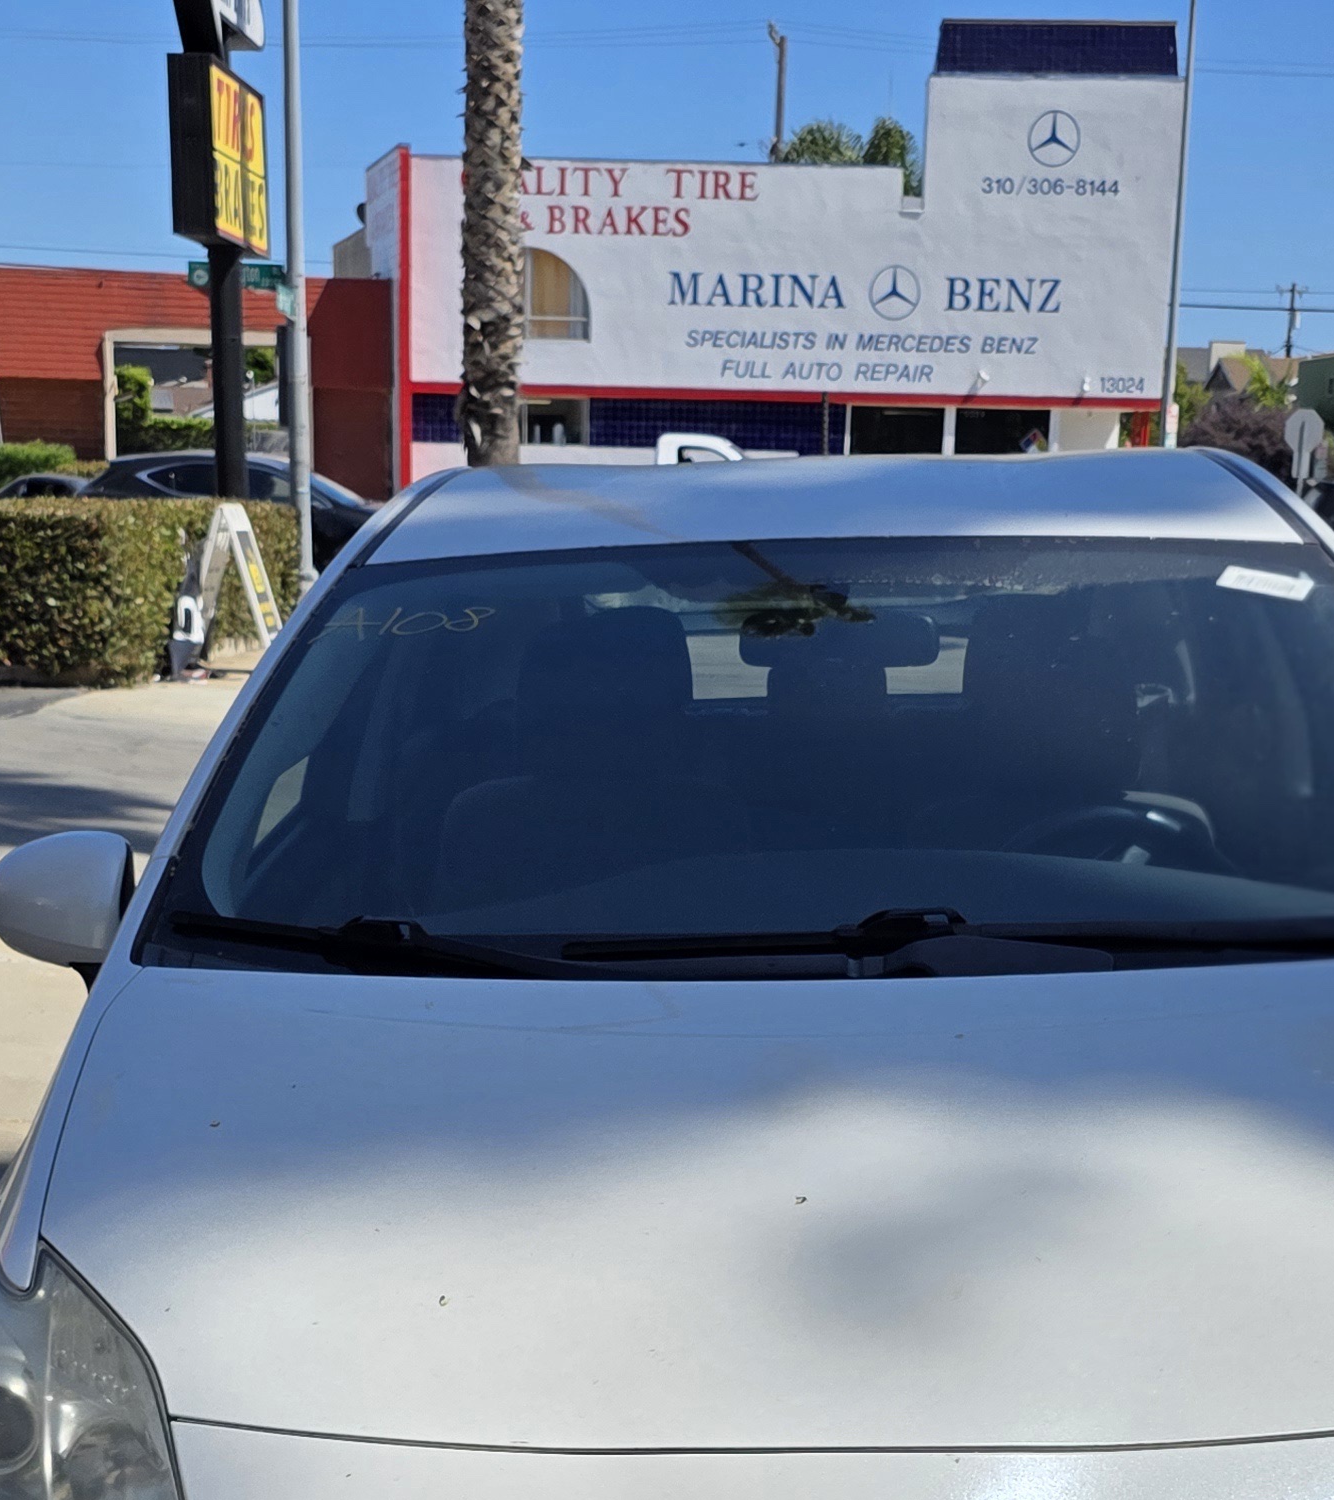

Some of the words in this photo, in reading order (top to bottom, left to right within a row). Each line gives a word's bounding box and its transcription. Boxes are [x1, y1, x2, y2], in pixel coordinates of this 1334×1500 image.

[665, 168, 760, 201] TIRE
[981, 176, 1120, 197] 310/306-8144
[546, 205, 691, 237] BRAKES
[667, 271, 847, 310] MARINA
[944, 276, 1062, 314] BENZ
[685, 329, 818, 351] SPECIALISTS
[826, 332, 848, 352] IN
[856, 333, 973, 354] MERCEDES
[980, 336, 1040, 355] BENZ
[720, 359, 772, 380] FULL
[782, 361, 843, 382] AUTO
[854, 363, 934, 384] REPAIR
[1099, 376, 1146, 394] 13024
